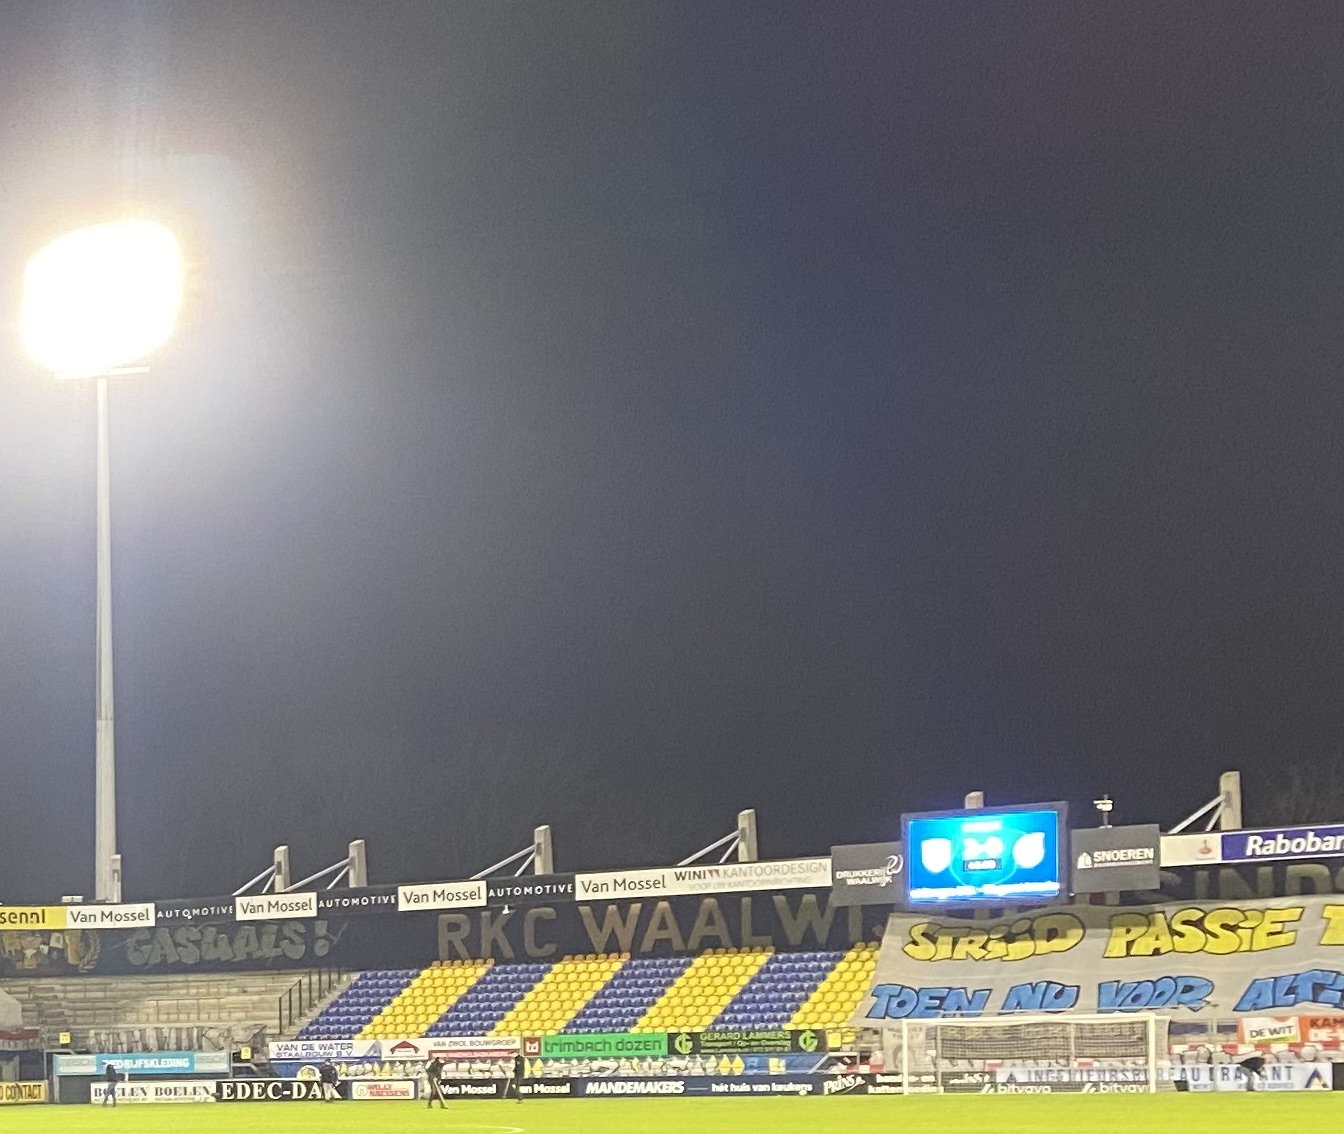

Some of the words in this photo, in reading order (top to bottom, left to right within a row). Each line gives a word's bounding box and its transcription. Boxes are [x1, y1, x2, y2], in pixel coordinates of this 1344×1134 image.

[1094, 847, 1154, 863] SNOEREN
[675, 869, 707, 882] WINI
[723, 862, 828, 879] KANTOORDESIGN
[581, 878, 610, 893] Van
[613, 875, 667, 891] Mossel
[403, 888, 430, 904] Van
[434, 886, 483, 902] Mossel
[488, 882, 574, 898] AUTOMOTIVE
[241, 901, 266, 915] Van
[268, 898, 313, 914] Mossel
[319, 894, 396, 908] AUTOMOTIVE
[70, 911, 97, 923] Van
[101, 908, 151, 923] Mossel
[157, 905, 234, 919] AUTOMOTIVE
[437, 907, 557, 960] RKC
[579, 892, 885, 954] WAALWI
[866, 983, 992, 1020] TOEN
[999, 980, 1080, 1015] NU
[1097, 975, 1215, 1013] VOOR
[276, 1043, 299, 1053] VAN
[302, 1043, 315, 1052] DE
[318, 1042, 353, 1052] WATER
[615, 1038, 662, 1052] dozen
[94, 1086, 149, 1098] BELEN
[460, 1084, 497, 1095] Mossel
[534, 1083, 570, 1094] Mossel
[586, 1081, 685, 1094] MANDEMAKERS
[998, 1082, 1051, 1094] bitvavo
